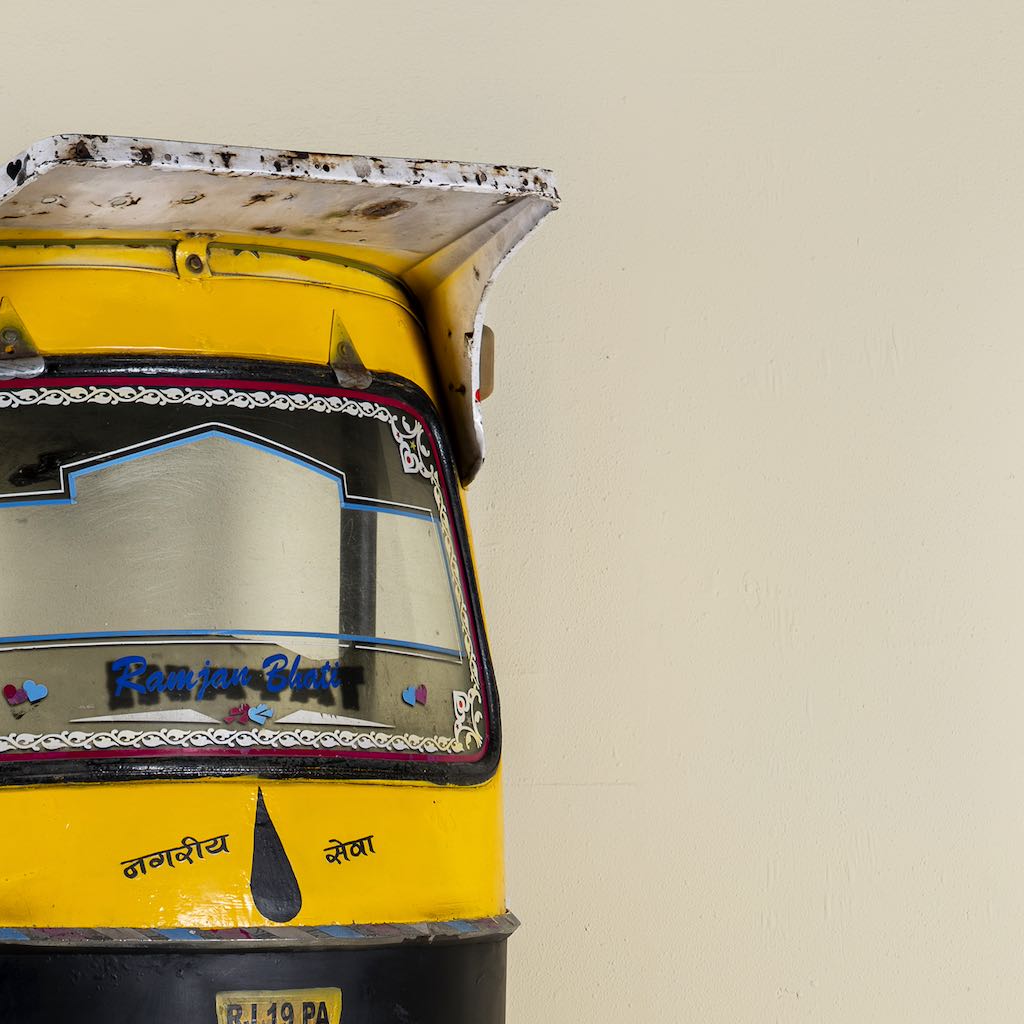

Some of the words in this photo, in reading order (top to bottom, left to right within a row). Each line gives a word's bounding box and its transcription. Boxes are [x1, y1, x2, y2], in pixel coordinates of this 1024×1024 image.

[111, 654, 251, 702] Ramjan
[262, 653, 343, 693] Bhati
[120, 833, 230, 879] नगरीय
[323, 834, 376, 865] सेवा
